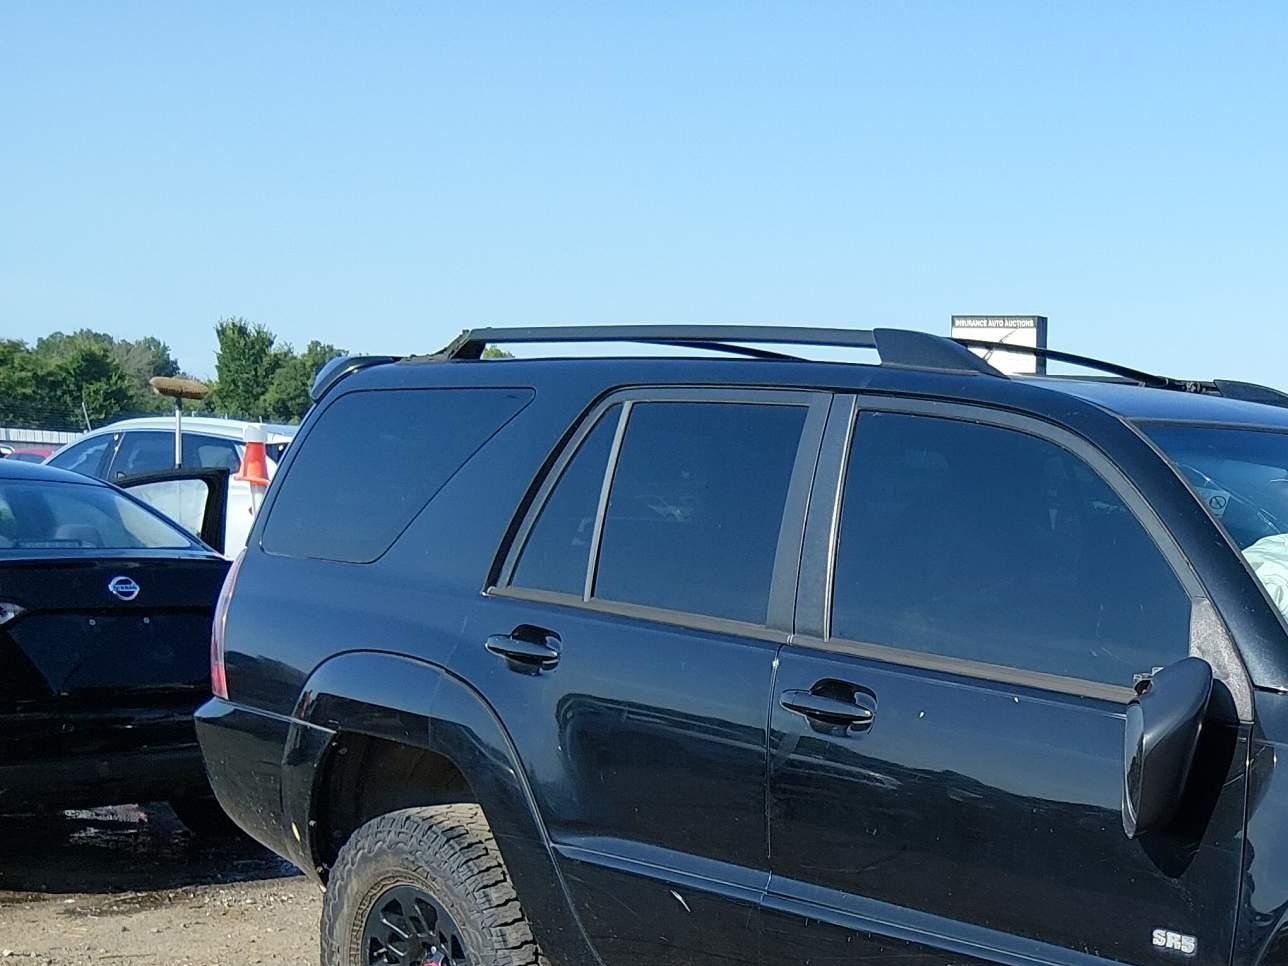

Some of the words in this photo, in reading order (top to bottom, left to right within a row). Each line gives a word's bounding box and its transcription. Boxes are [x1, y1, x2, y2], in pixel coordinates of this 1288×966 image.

[988, 320, 1003, 328] AUTO
[1004, 319, 1034, 328] AUCTIONS
[1152, 929, 1197, 955] SR5
